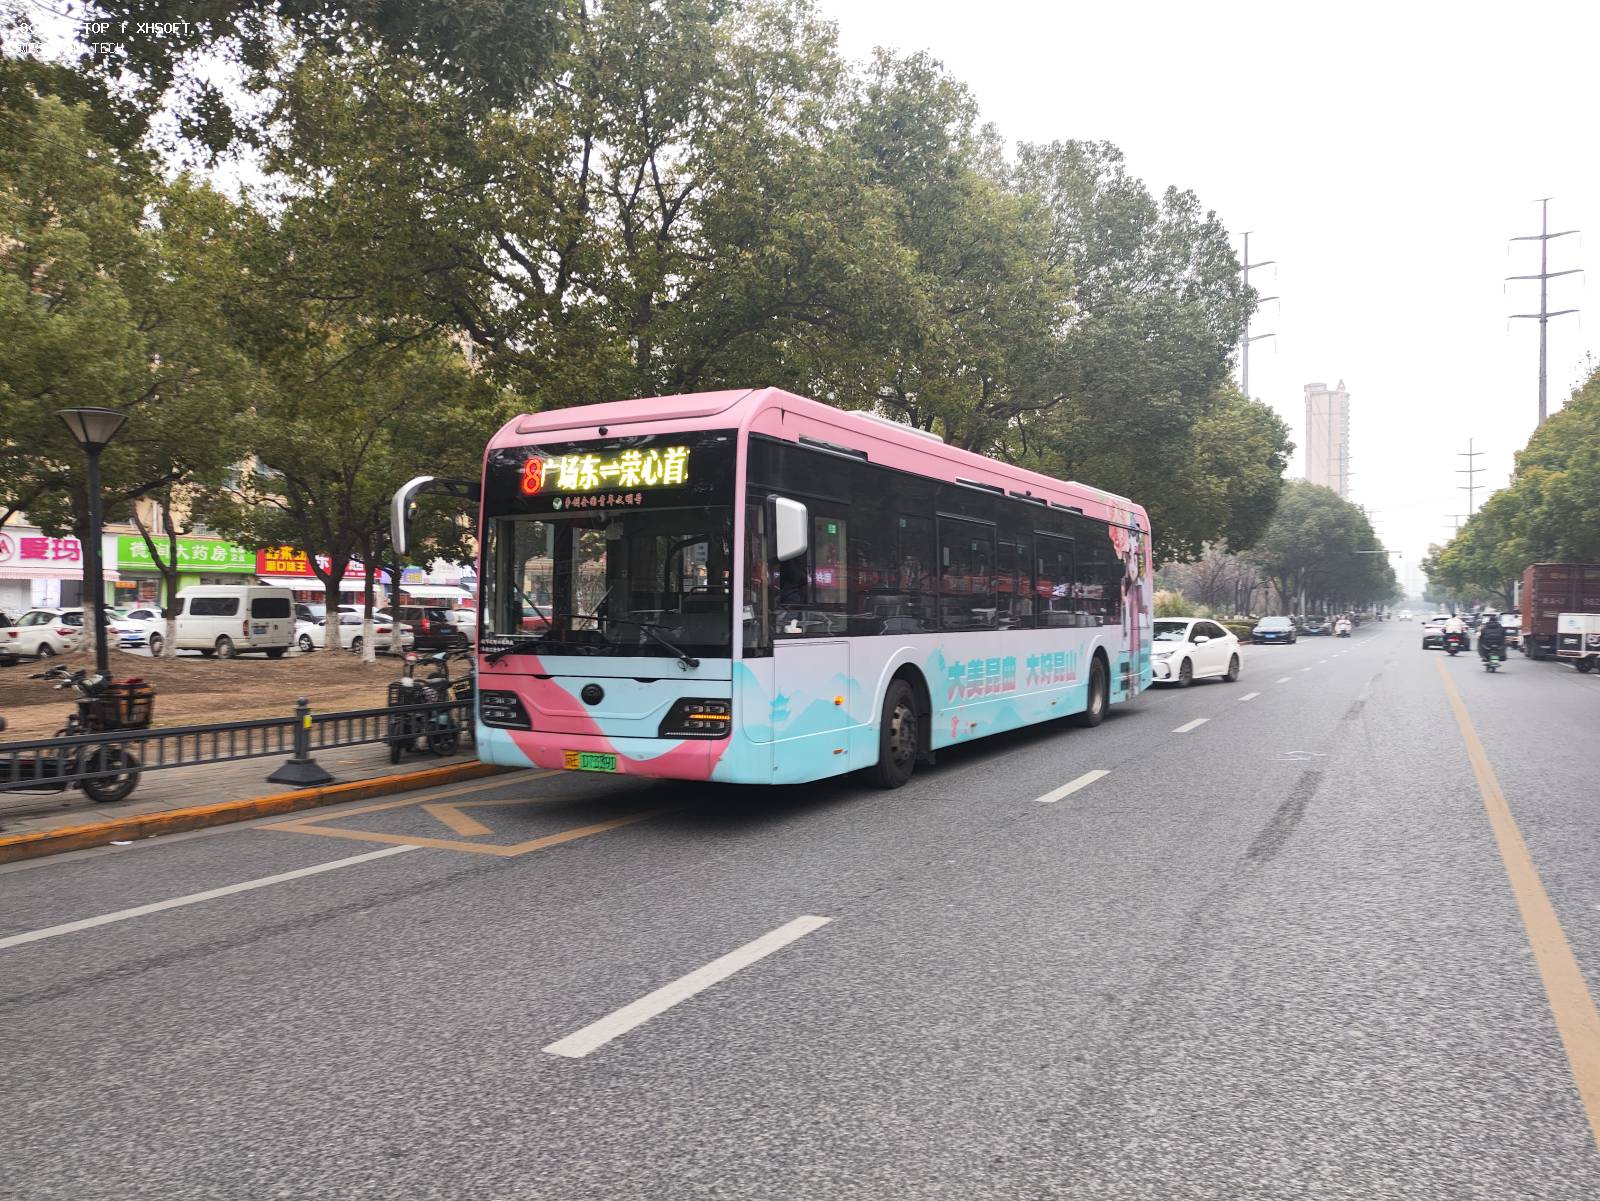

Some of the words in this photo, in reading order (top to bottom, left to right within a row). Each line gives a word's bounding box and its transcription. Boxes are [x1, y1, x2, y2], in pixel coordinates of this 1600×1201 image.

[521, 458, 543, 495] 8
[541, 455, 601, 490] 广场东
[619, 446, 690, 488] 荣心首
[20, 537, 80, 561] 爱玛
[948, 656, 1016, 701] 大美昆曲
[1026, 651, 1077, 687] 大好昆山
